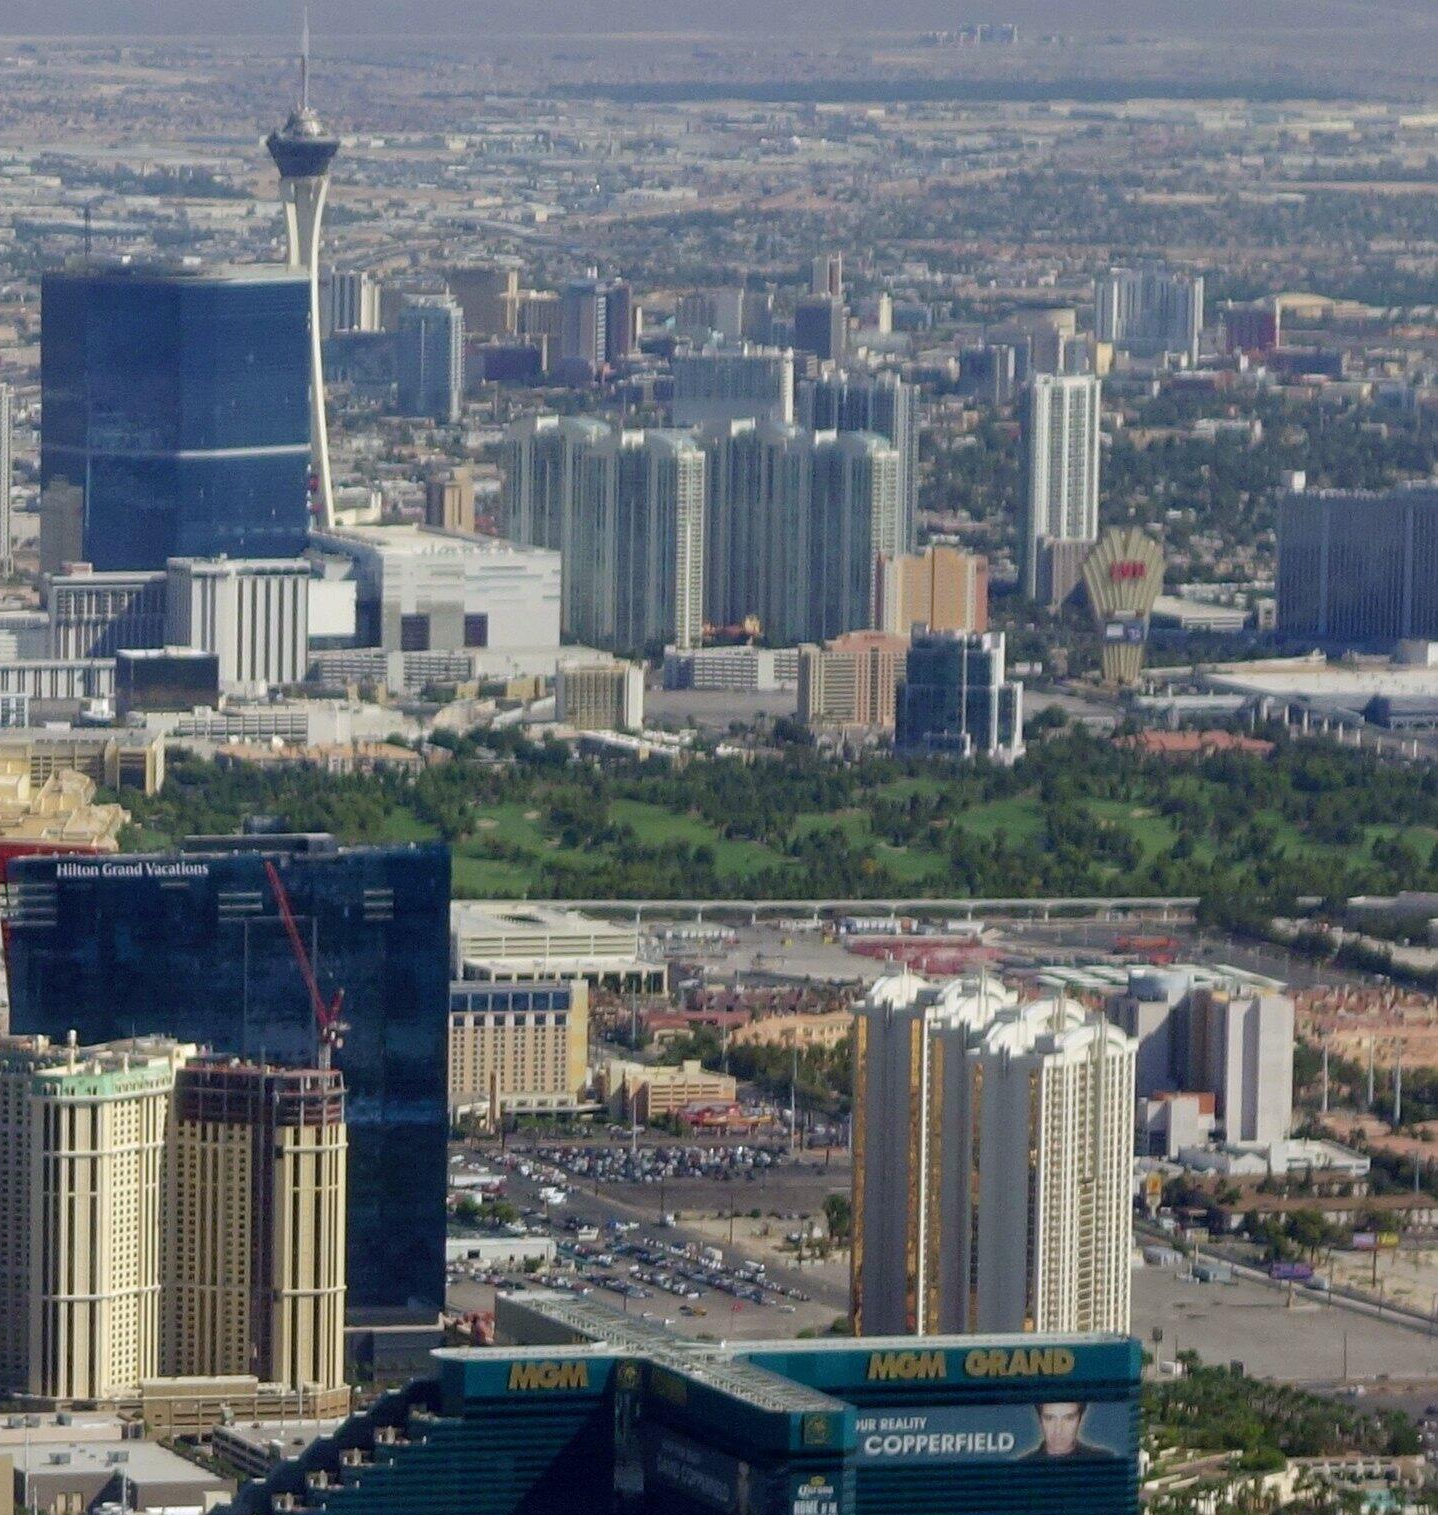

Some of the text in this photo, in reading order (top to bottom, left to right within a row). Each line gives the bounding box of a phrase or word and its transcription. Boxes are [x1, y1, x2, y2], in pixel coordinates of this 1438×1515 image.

[56, 861, 209, 877] Hilton Grand Vacations
[508, 1360, 589, 1391] MGM
[867, 1348, 1075, 1380] MGM GRAND
[880, 1416, 928, 1431] REALITY
[864, 1432, 1015, 1455] COPPERFIELD
